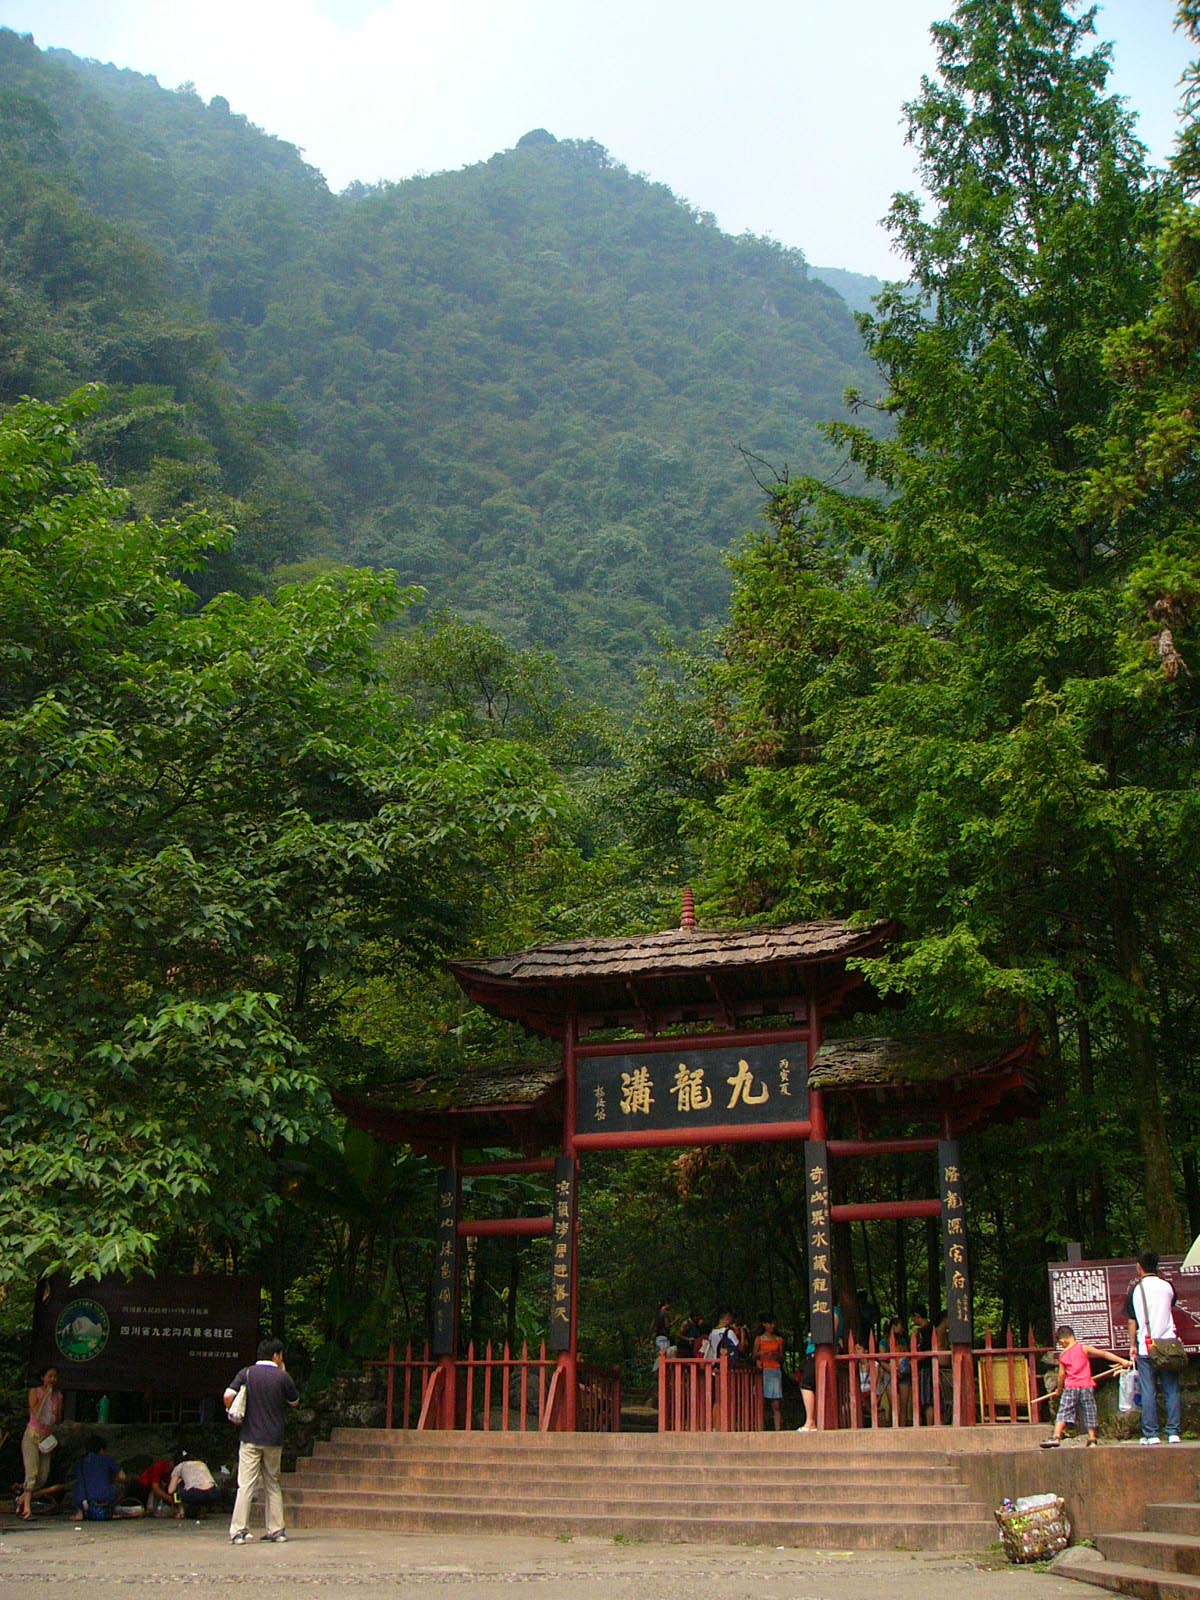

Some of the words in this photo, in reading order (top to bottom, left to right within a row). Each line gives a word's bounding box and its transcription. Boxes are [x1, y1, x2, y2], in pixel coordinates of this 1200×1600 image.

[120, 1326, 233, 1338] 四川省九龙沟风景名胜区
